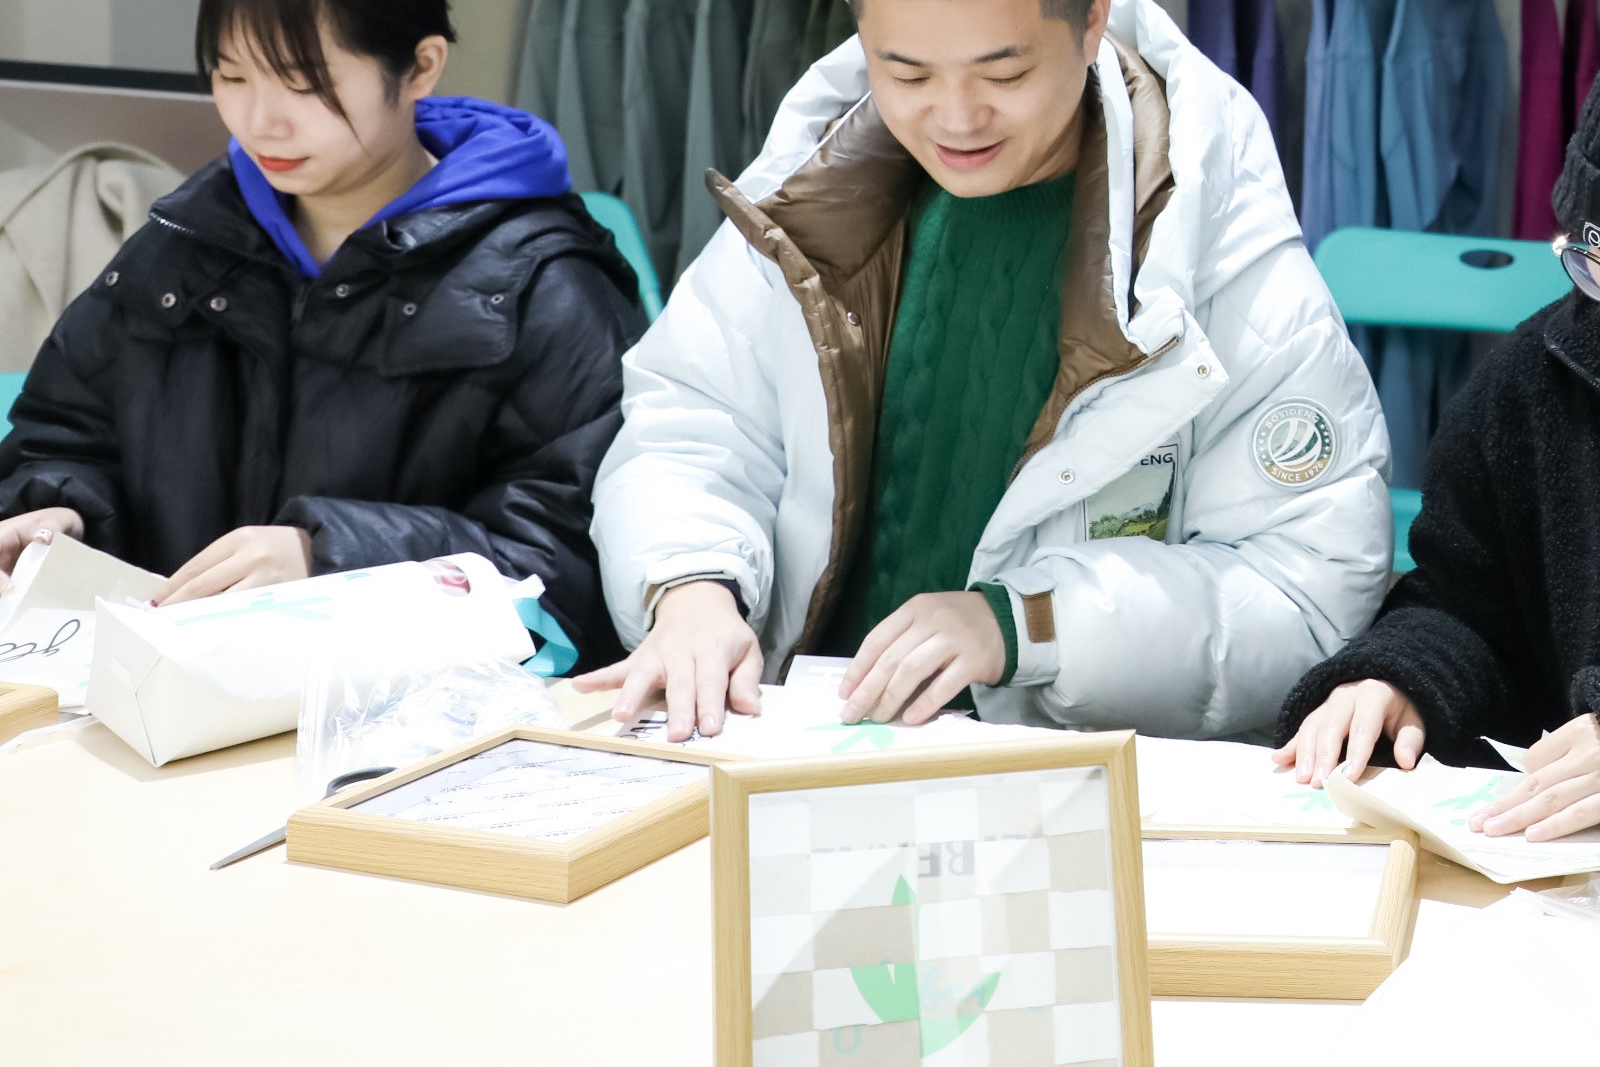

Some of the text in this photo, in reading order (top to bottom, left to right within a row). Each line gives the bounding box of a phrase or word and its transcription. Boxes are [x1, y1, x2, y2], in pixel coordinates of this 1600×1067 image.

[1264, 408, 1321, 429] BOSIDENG
[1271, 462, 1324, 481] SINCE 1976
